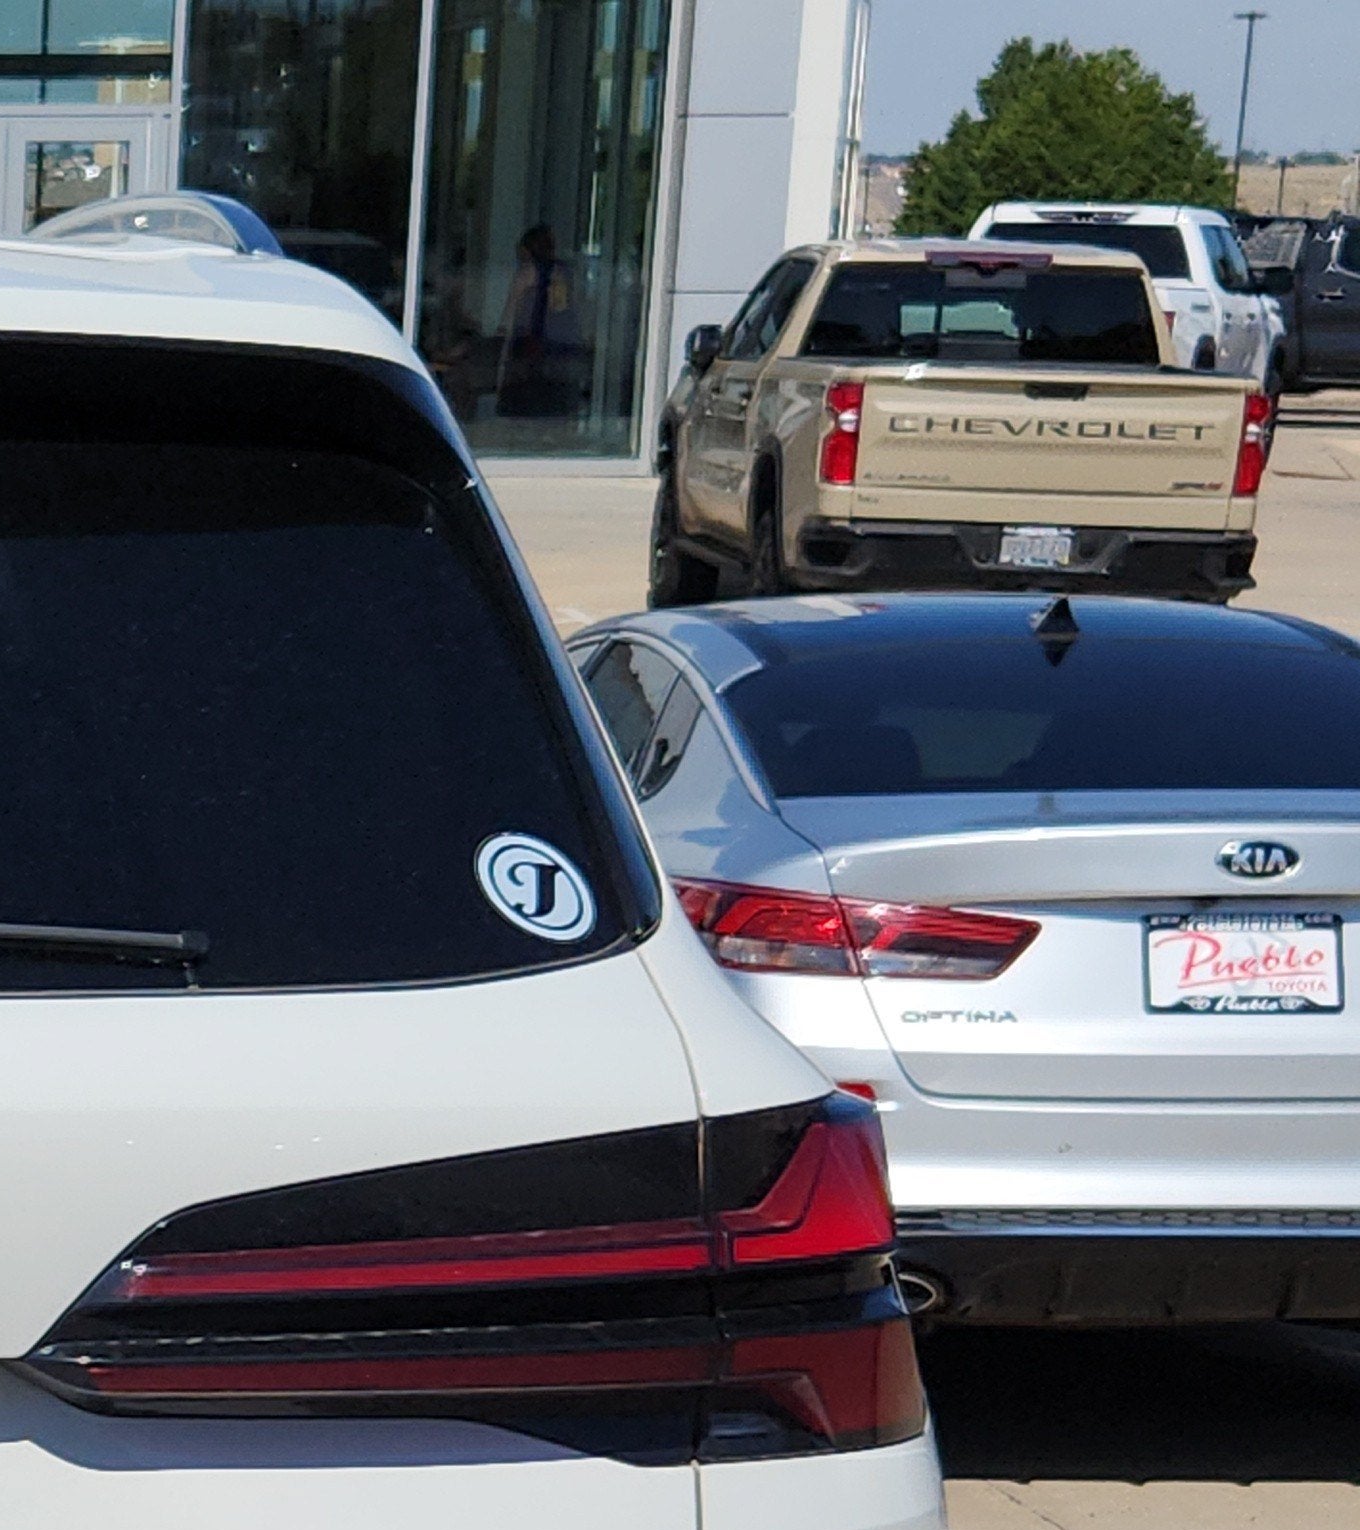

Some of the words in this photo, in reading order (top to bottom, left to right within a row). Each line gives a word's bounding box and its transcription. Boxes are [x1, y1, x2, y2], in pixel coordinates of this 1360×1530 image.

[888, 415, 1215, 441] CHEVROLET
[1230, 848, 1287, 873] KIA
[1153, 931, 1325, 980] Pueblo
[1268, 979, 1328, 992] TOYOTA
[900, 1009, 1019, 1024] OPTIMA
